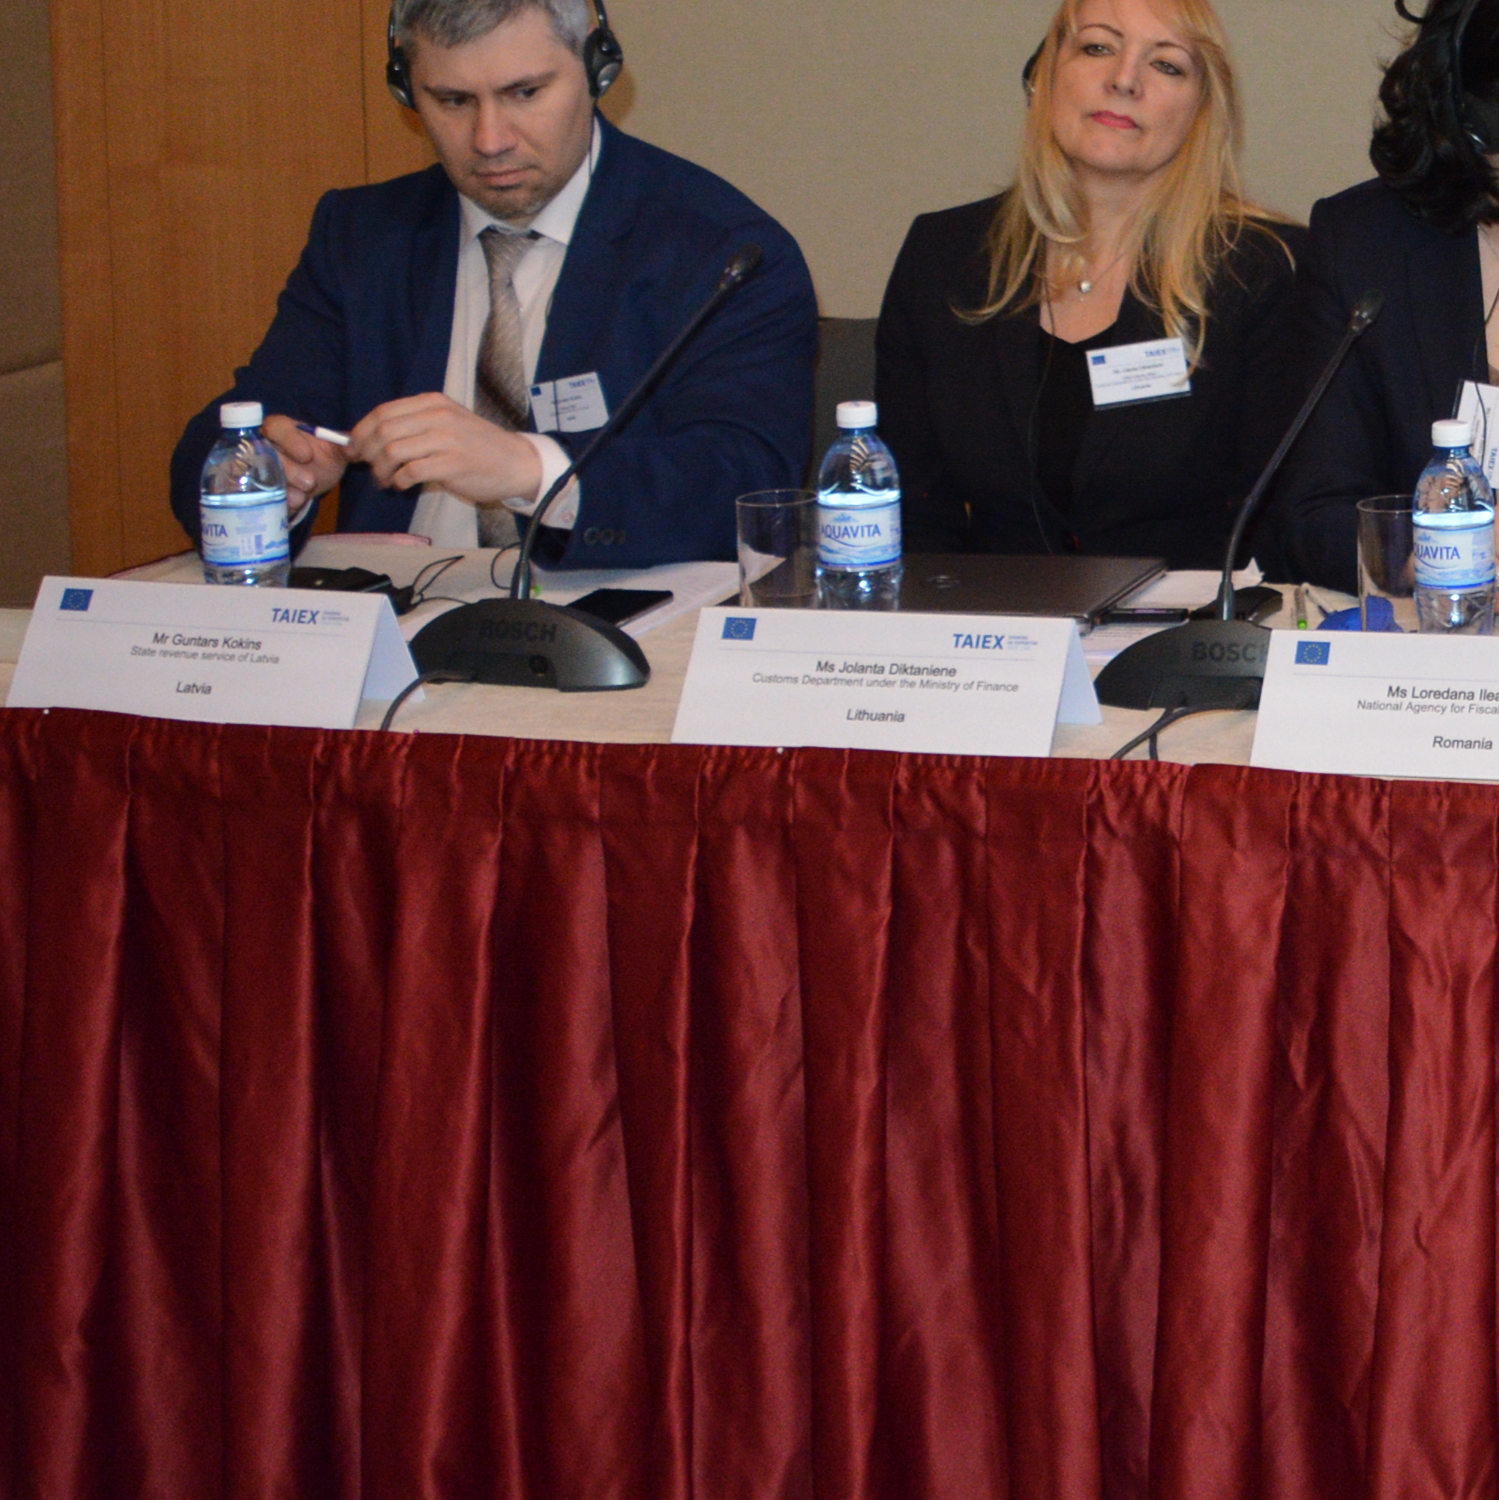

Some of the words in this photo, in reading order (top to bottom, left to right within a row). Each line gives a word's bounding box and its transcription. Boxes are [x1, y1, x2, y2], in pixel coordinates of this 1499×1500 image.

[272, 608, 319, 624] TAIEX
[152, 633, 169, 644] Mr
[172, 634, 218, 648] Guntars
[222, 637, 262, 650] Kokins
[952, 633, 1005, 650] TAIEX
[131, 645, 156, 657] State
[159, 649, 198, 659] revenue
[200, 651, 236, 662] service
[237, 652, 249, 662] of
[250, 653, 280, 664] Latvia
[815, 660, 835, 673] Ms
[838, 661, 885, 675] Jolanta
[888, 663, 957, 678] Diktaniene
[176, 681, 212, 695] Latvia
[752, 672, 799, 685] Customs
[801, 674, 864, 690] Department
[865, 677, 896, 689] under
[899, 678, 917, 690] the
[919, 679, 960, 693] Ministry
[962, 680, 976, 691] of
[976, 681, 1019, 693] Finance
[1387, 685, 1407, 699] Ms
[1411, 686, 1475, 701] Loredana
[846, 708, 906, 723] Lithuania
[1357, 700, 1402, 712] National
[1405, 701, 1447, 715] Agency
[1450, 703, 1465, 714] for
[1468, 704, 1499, 715] Fiscal
[1432, 735, 1493, 750] Romania
